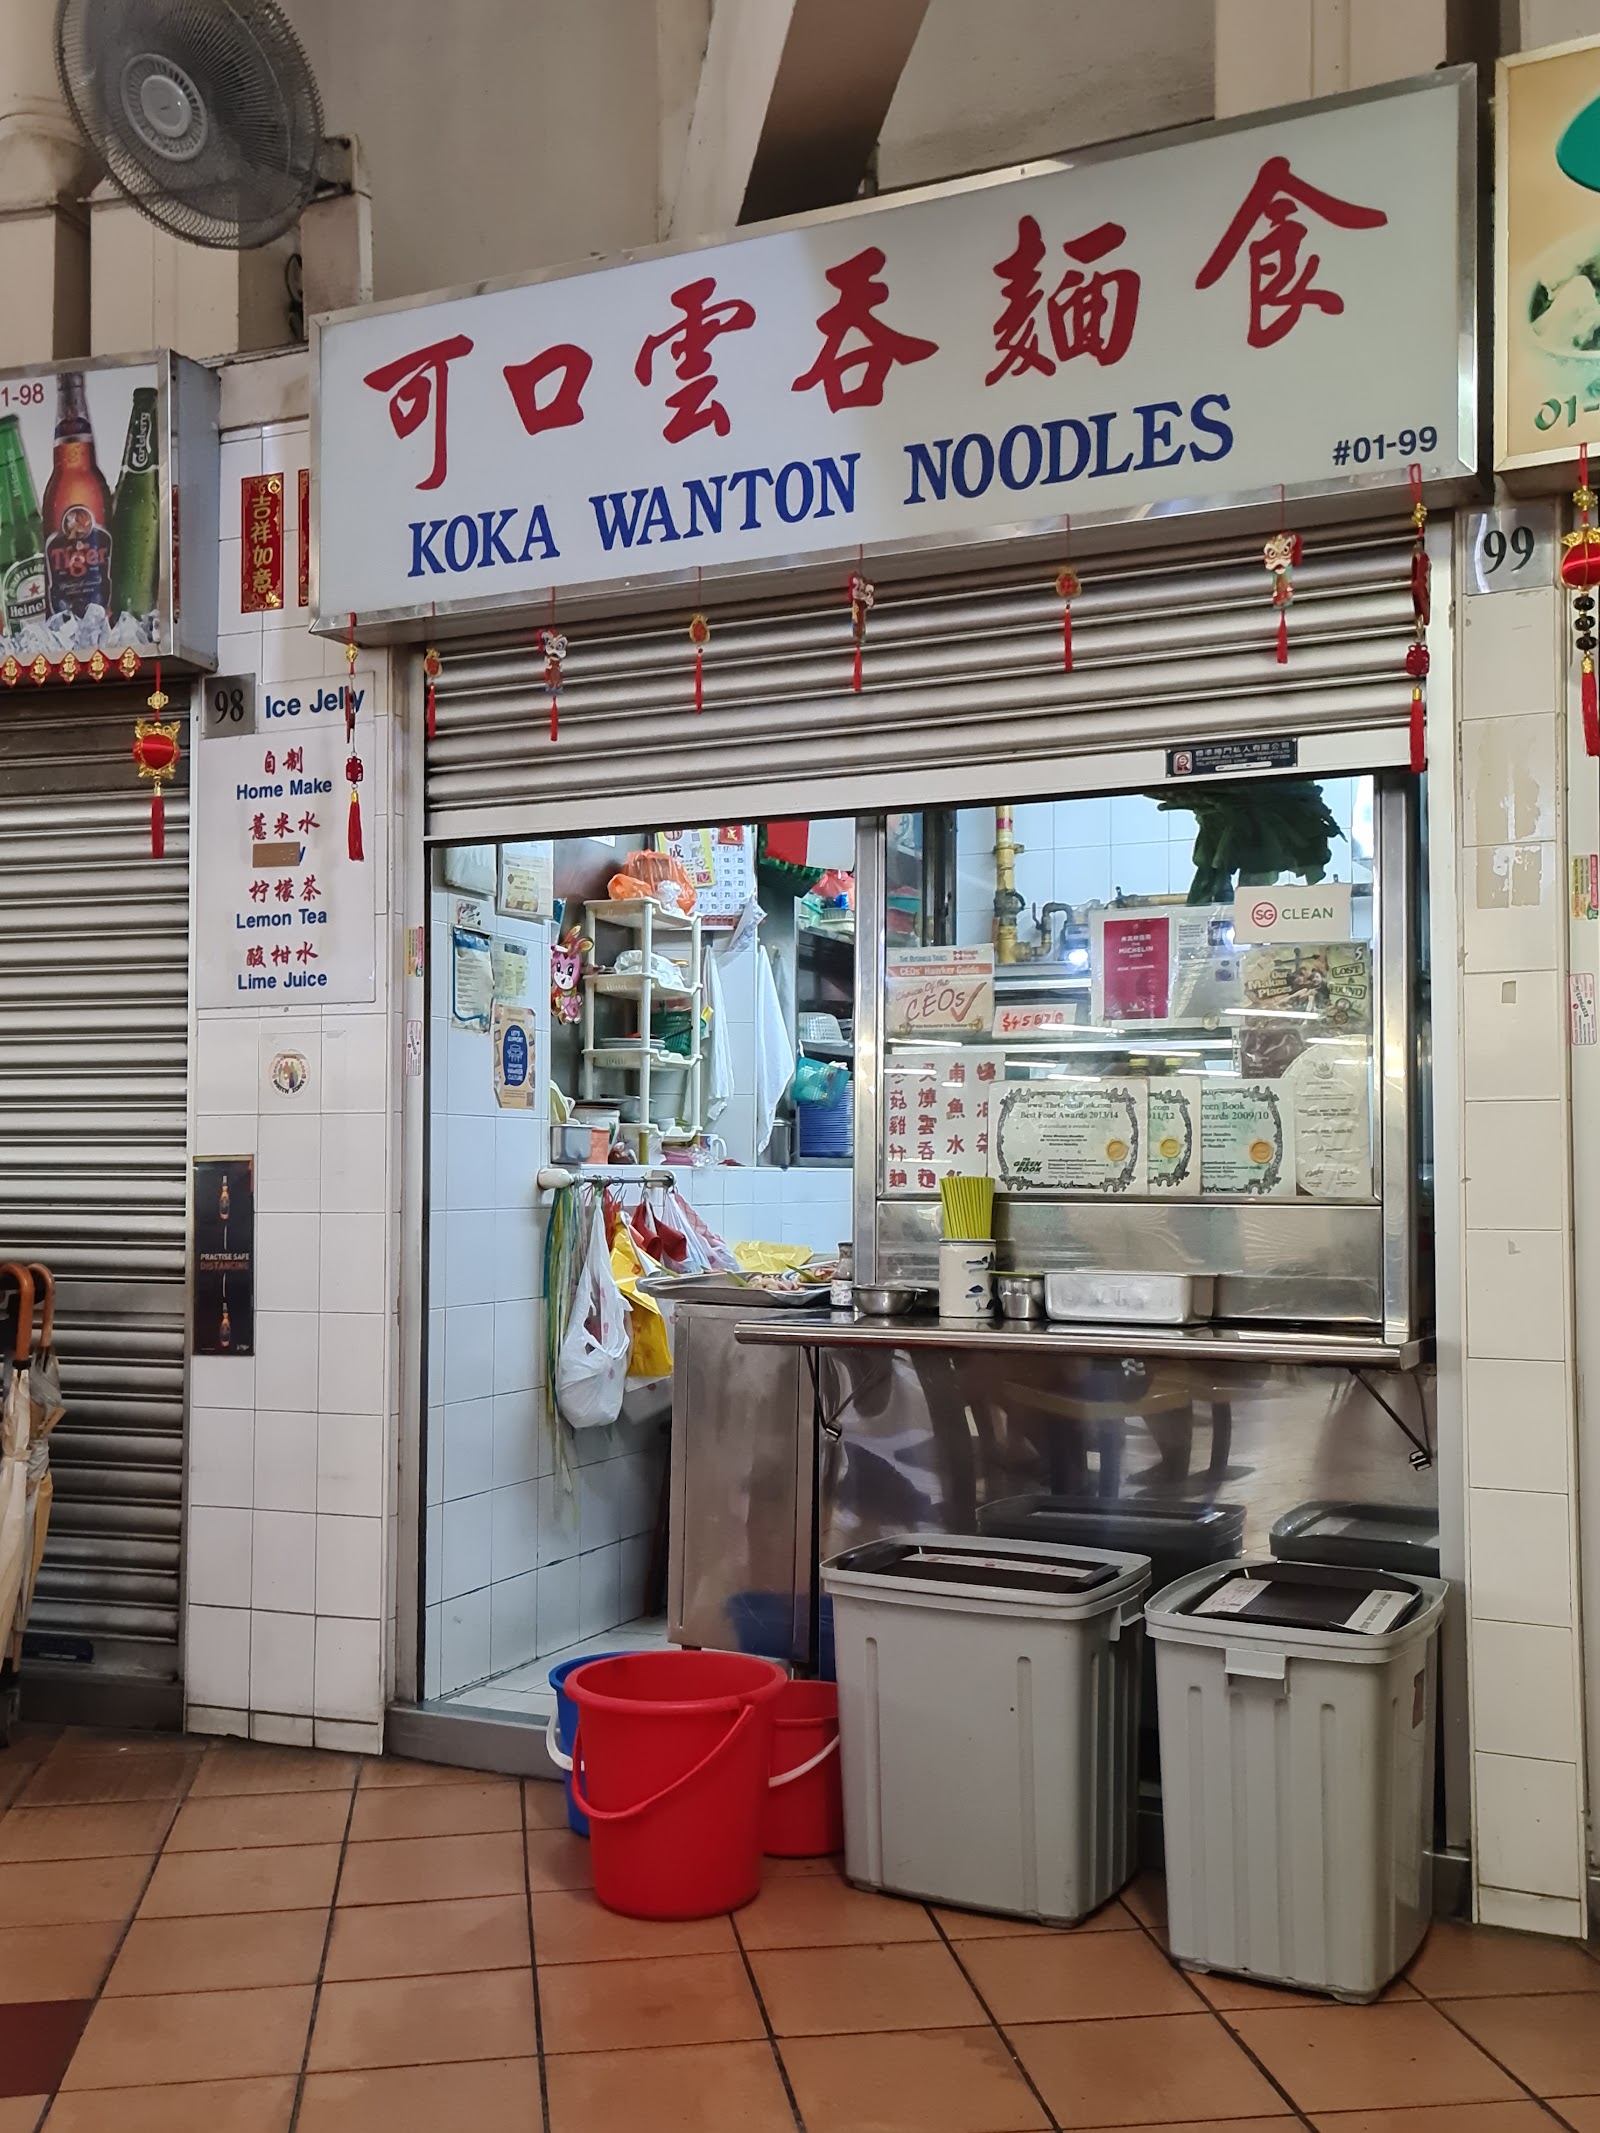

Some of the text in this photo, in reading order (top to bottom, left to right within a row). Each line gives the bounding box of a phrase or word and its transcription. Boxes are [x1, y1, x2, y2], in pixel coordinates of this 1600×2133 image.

[132, 412, 152, 469] Carlsberg
[1331, 424, 1439, 467] #01-99
[407, 393, 1235, 578] KOKA WANTON NOODLES
[250, 495, 274, 594] 吉祥如意
[1483, 525, 1535, 575] 99
[51, 544, 107, 577] Tiger
[213, 688, 244, 724] 98
[265, 686, 365, 718] Ice Jely
[236, 777, 333, 801] Home Make
[248, 874, 322, 903] 柠檬茶
[236, 908, 327, 929] Lemon Tea
[1255, 907, 1334, 920] SG CLEAN
[246, 940, 319, 968] 酸柑水
[237, 970, 327, 990] Lime Juice
[924, 966, 955, 975] Hawker
[956, 965, 981, 974] Guide
[1334, 965, 1360, 975] LOST
[1247, 979, 1288, 991] Makan
[1201, 1111, 1269, 1121] wards 2009/10
[1221, 1101, 1245, 1110] Book
[200, 1252, 250, 1261] PRACTISE SAFE
